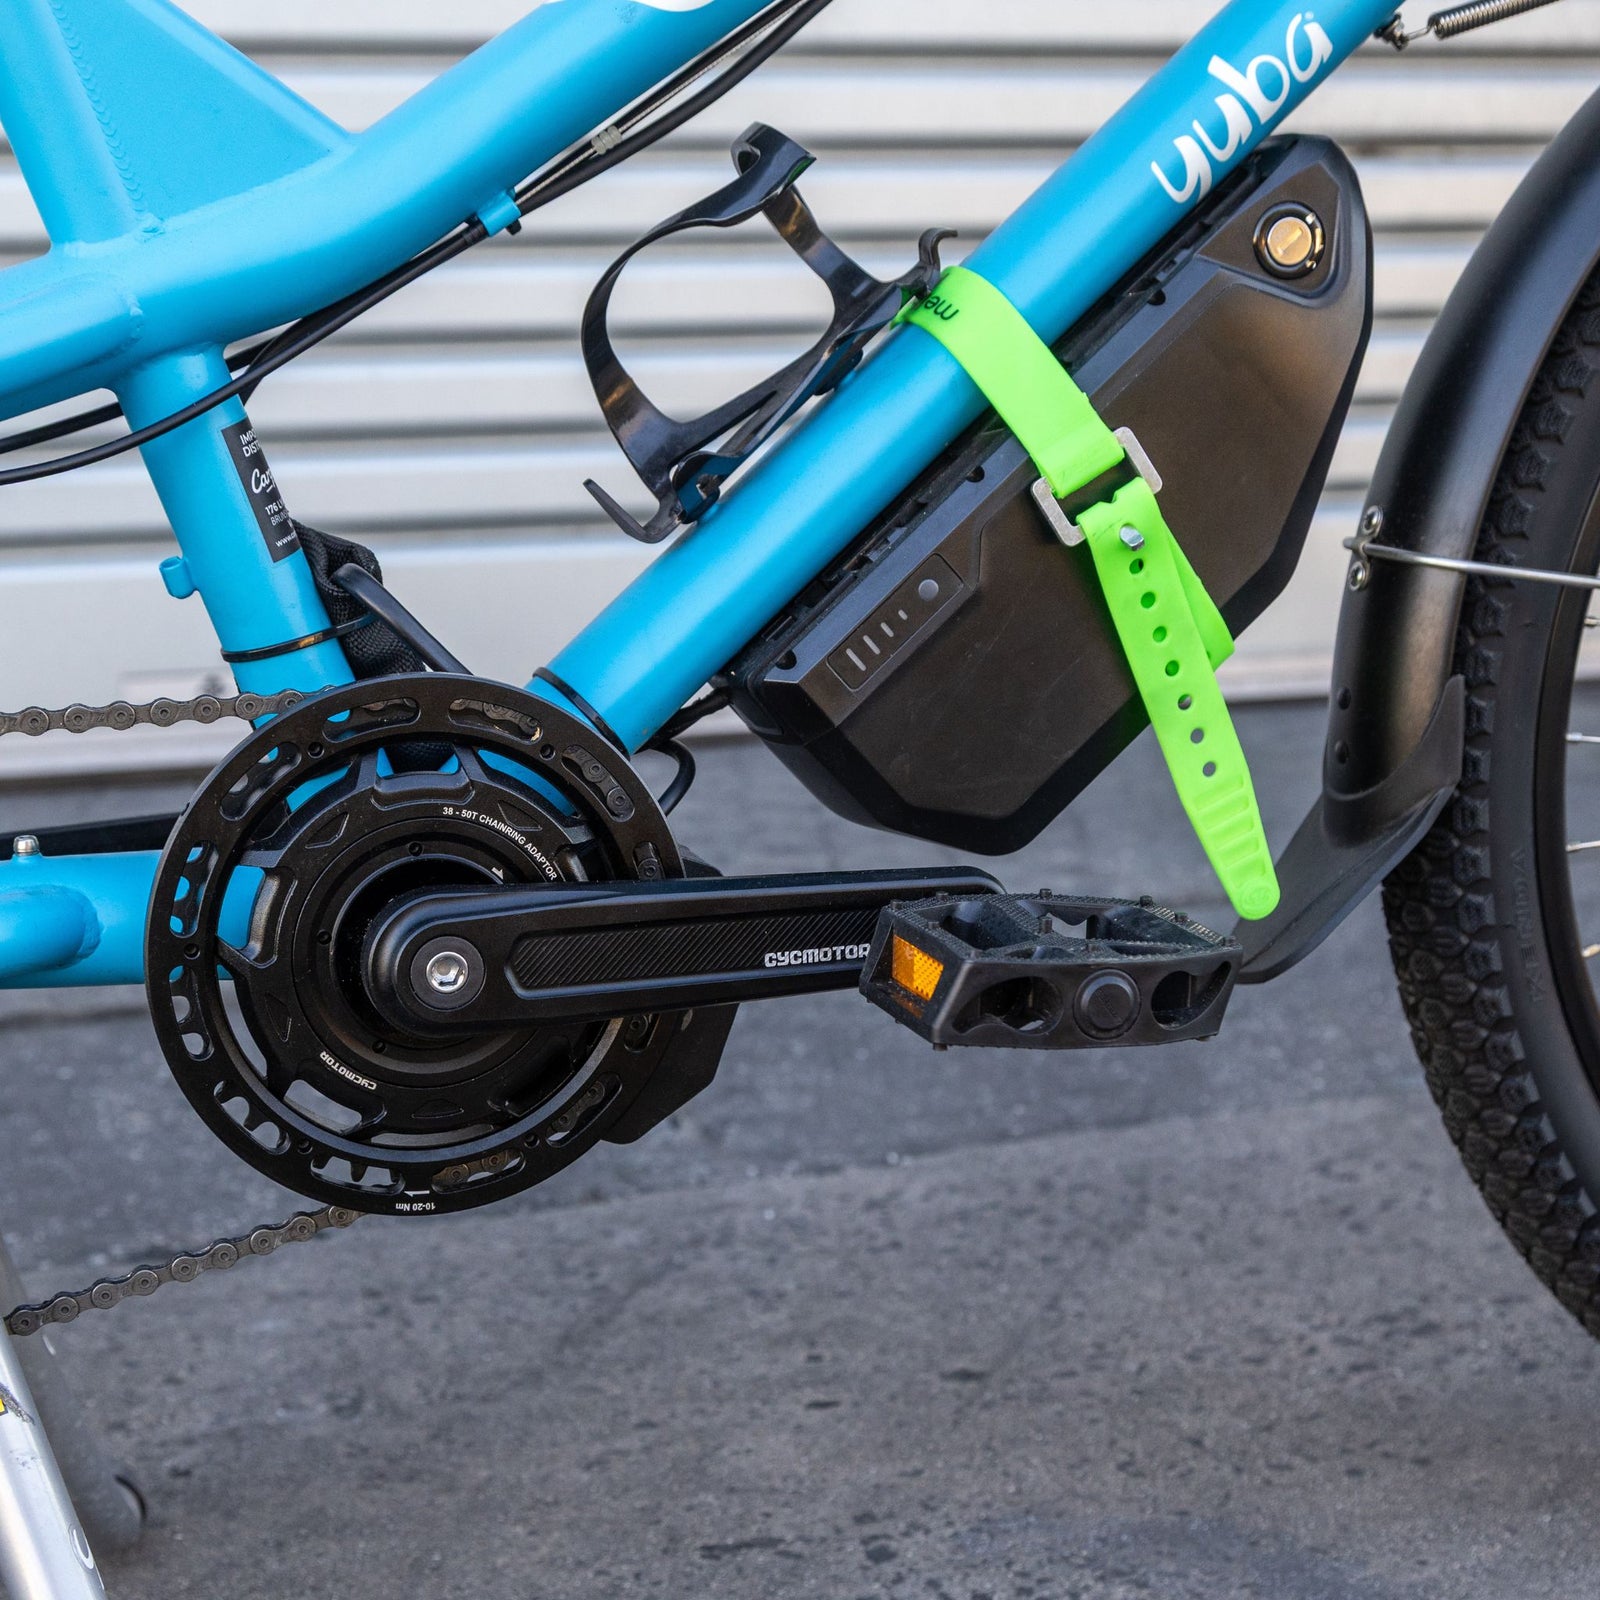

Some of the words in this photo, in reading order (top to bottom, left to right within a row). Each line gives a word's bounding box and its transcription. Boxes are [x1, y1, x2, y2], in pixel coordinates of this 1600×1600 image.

[1150, 11, 1333, 204] yuba
[265, 502, 279, 515] 176
[442, 806, 454, 816] 38
[461, 809, 479, 820] 50T
[479, 814, 526, 845] CHAINRING
[524, 843, 558, 881] ADAPTOR
[319, 1050, 378, 1091] CYCMOTOR
[395, 1203, 411, 1212] Nm
[412, 1202, 436, 1211] 10-20
